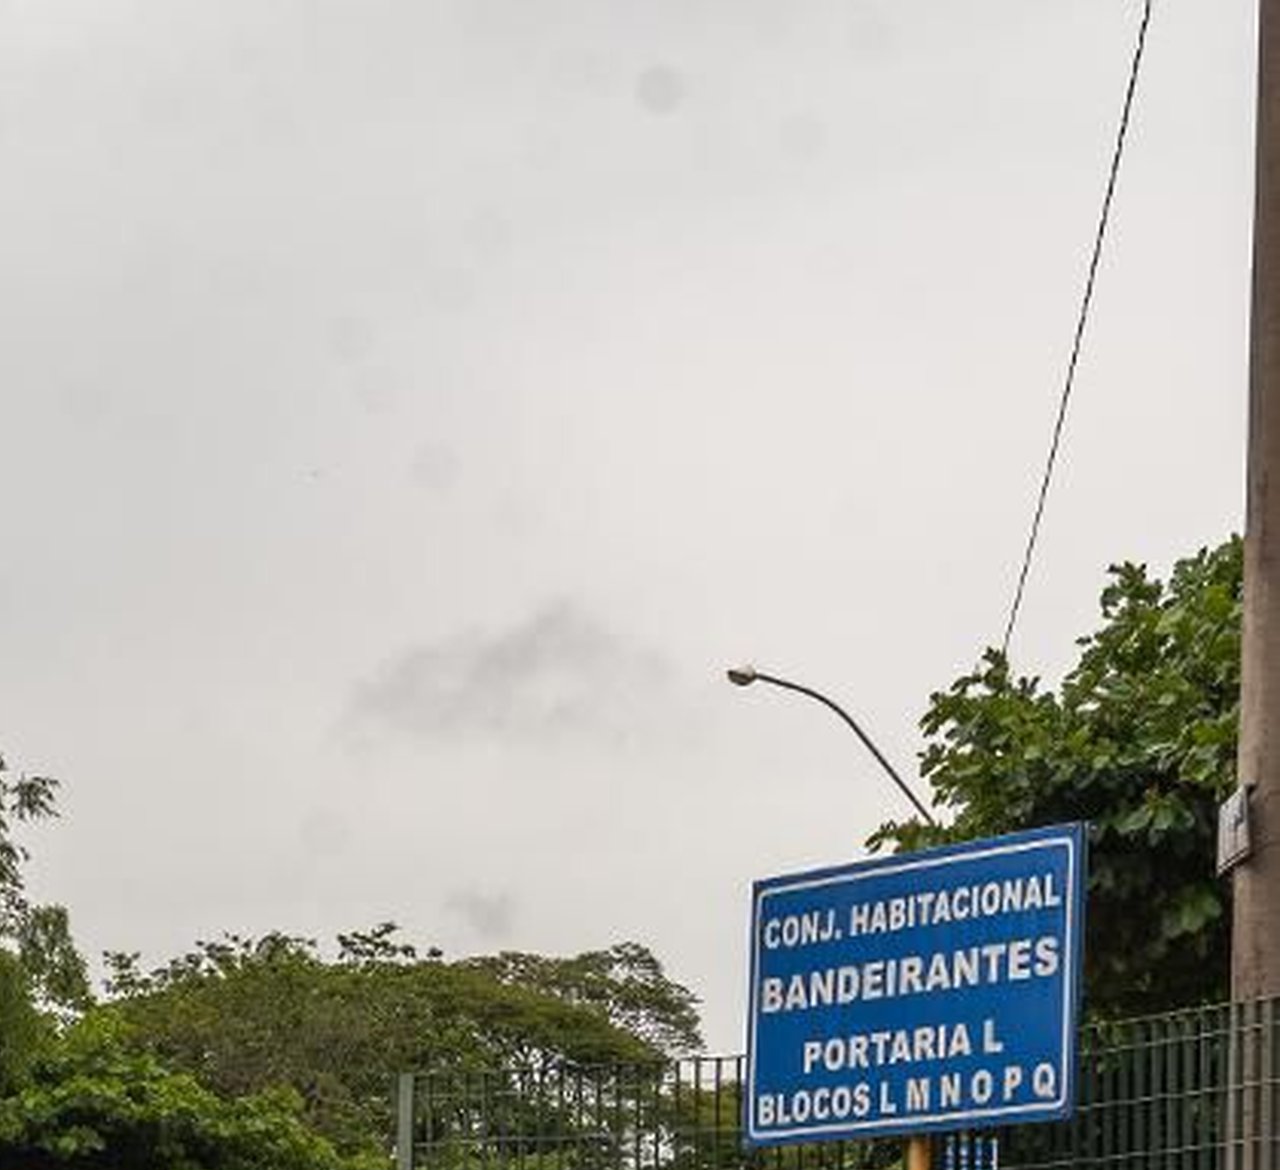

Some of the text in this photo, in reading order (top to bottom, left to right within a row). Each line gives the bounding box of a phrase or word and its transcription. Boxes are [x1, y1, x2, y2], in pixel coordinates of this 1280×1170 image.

[765, 873, 1060, 949] CONJ. HABITACIONAL
[762, 937, 1059, 1013] BANDEIRANTES
[804, 1019, 1003, 1073] PORTARIA L
[758, 1062, 1055, 1126] BLOCOS L M N O P Q
